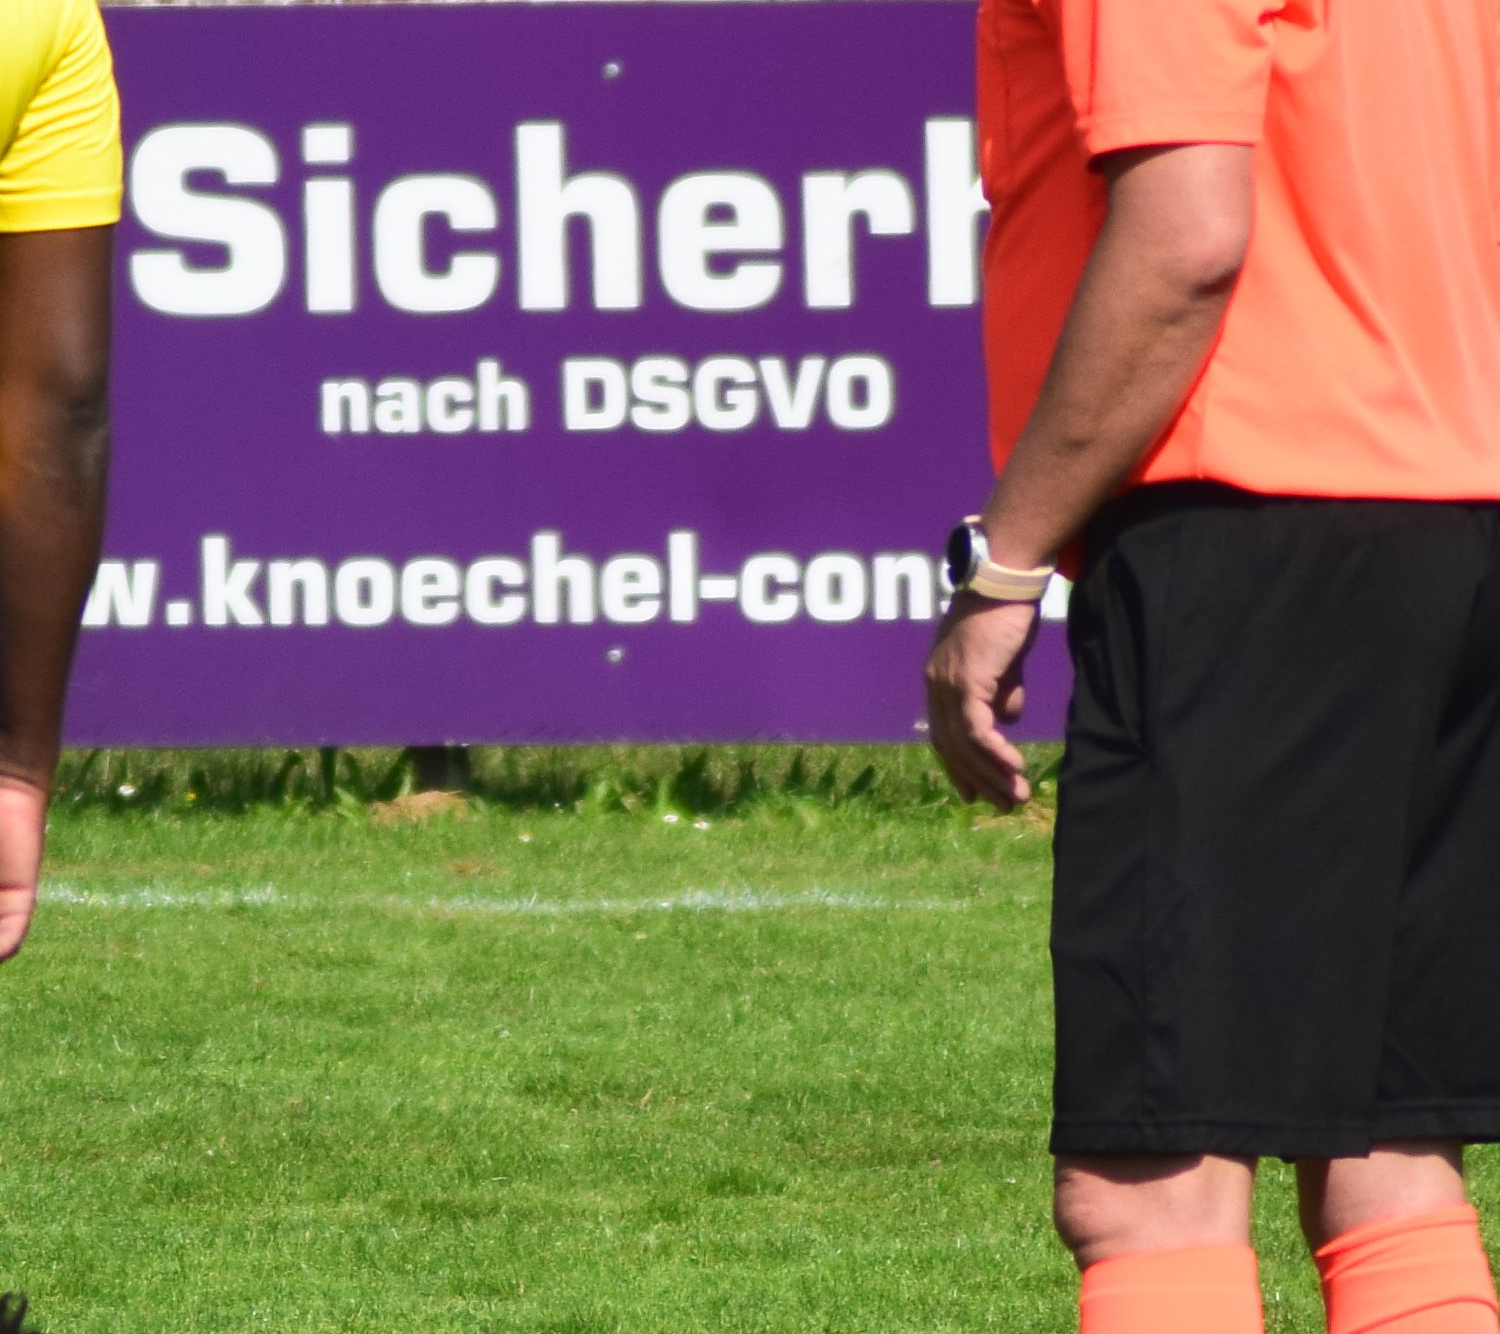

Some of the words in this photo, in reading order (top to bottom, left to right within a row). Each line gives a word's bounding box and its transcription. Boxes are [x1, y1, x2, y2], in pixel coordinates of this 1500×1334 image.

[320, 358, 529, 435] nach
[562, 355, 896, 431] DSGVO
[80, 530, 1070, 629] w.knoechel-con
